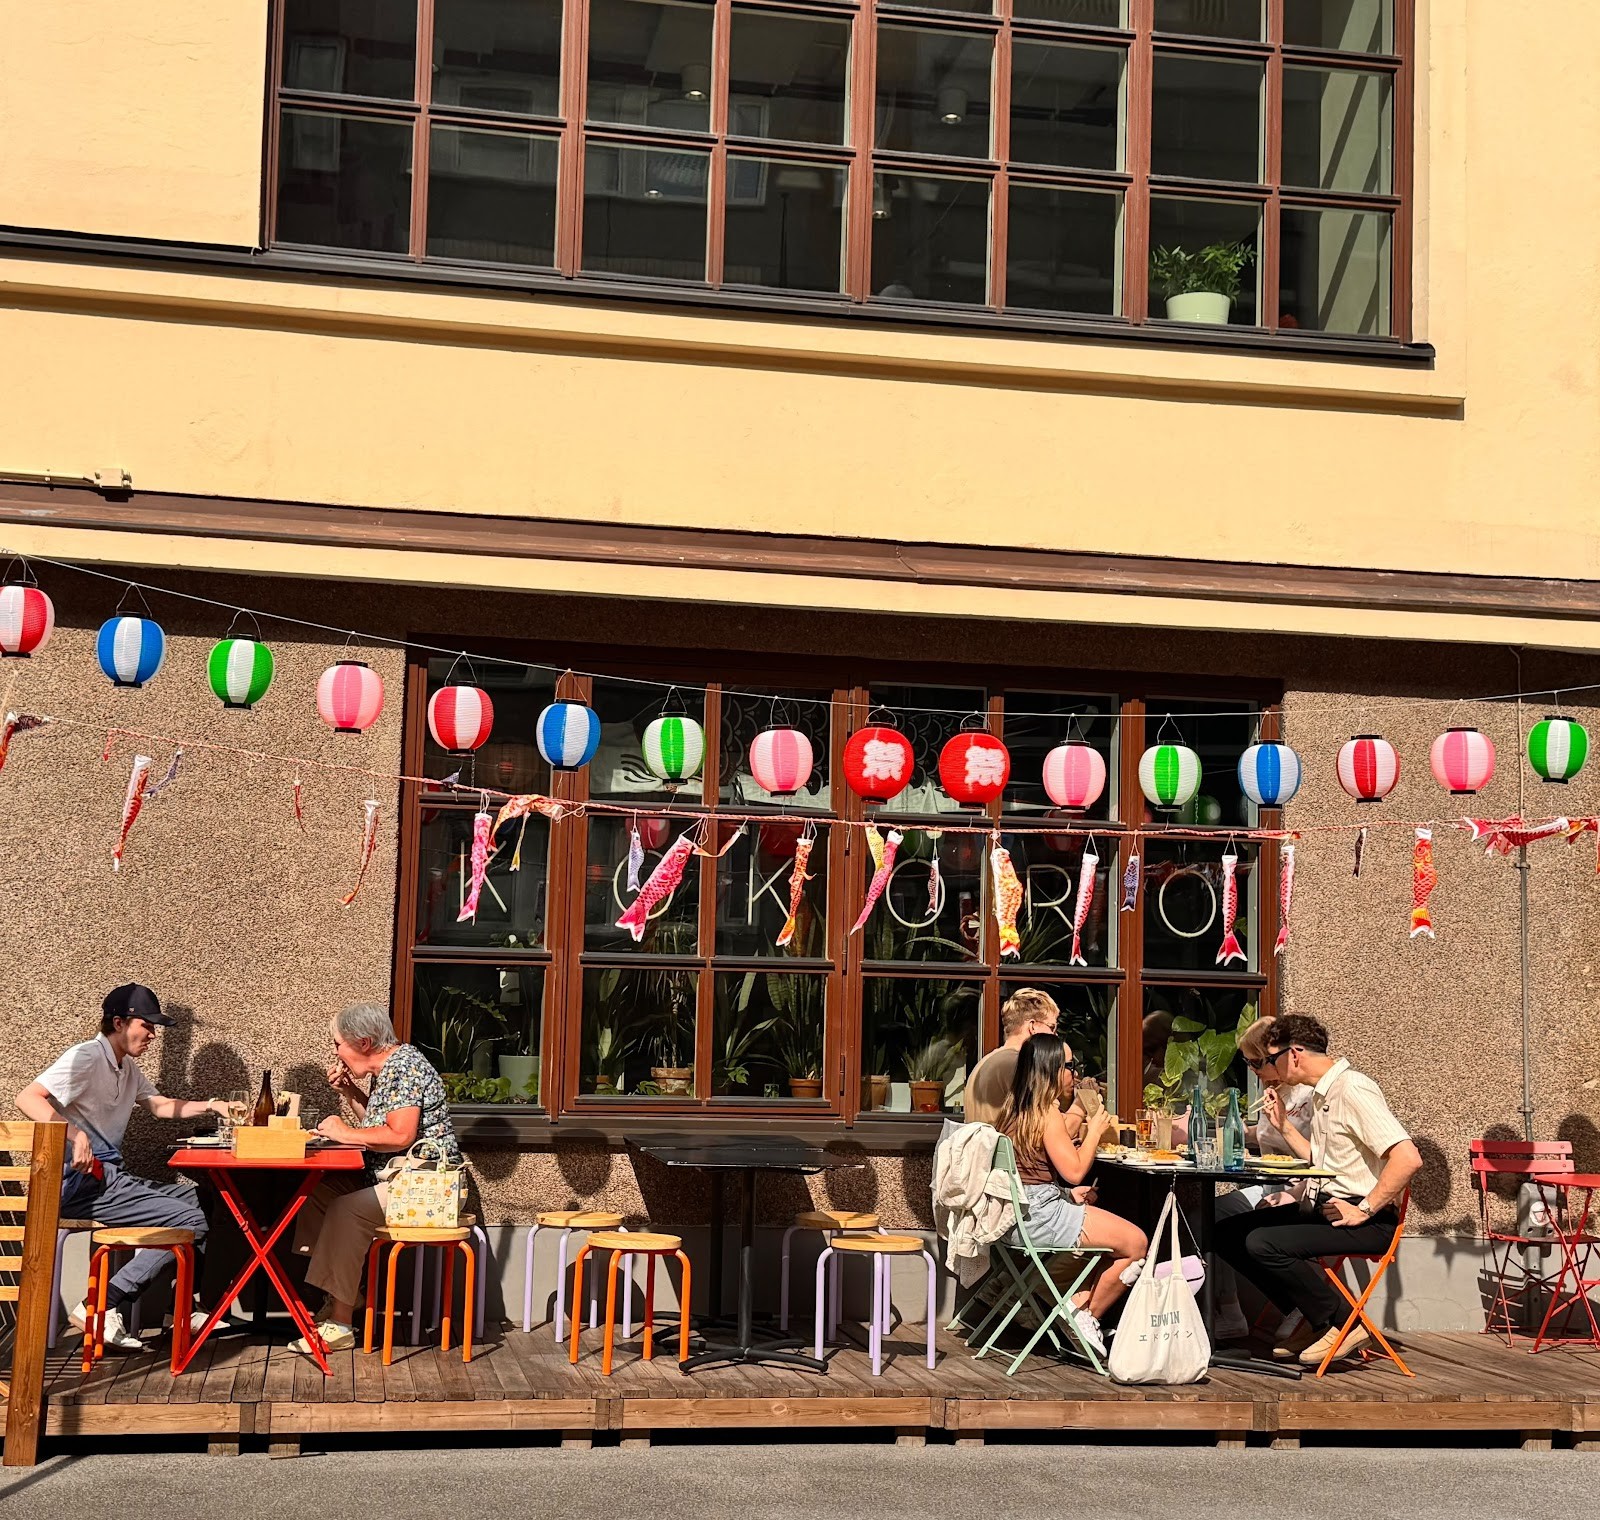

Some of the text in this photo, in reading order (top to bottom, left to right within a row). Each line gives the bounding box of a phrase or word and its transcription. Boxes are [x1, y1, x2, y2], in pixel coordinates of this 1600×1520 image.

[1151, 1311, 1180, 1327] EDWIN
[1139, 1331, 1193, 1342] エドウイン
